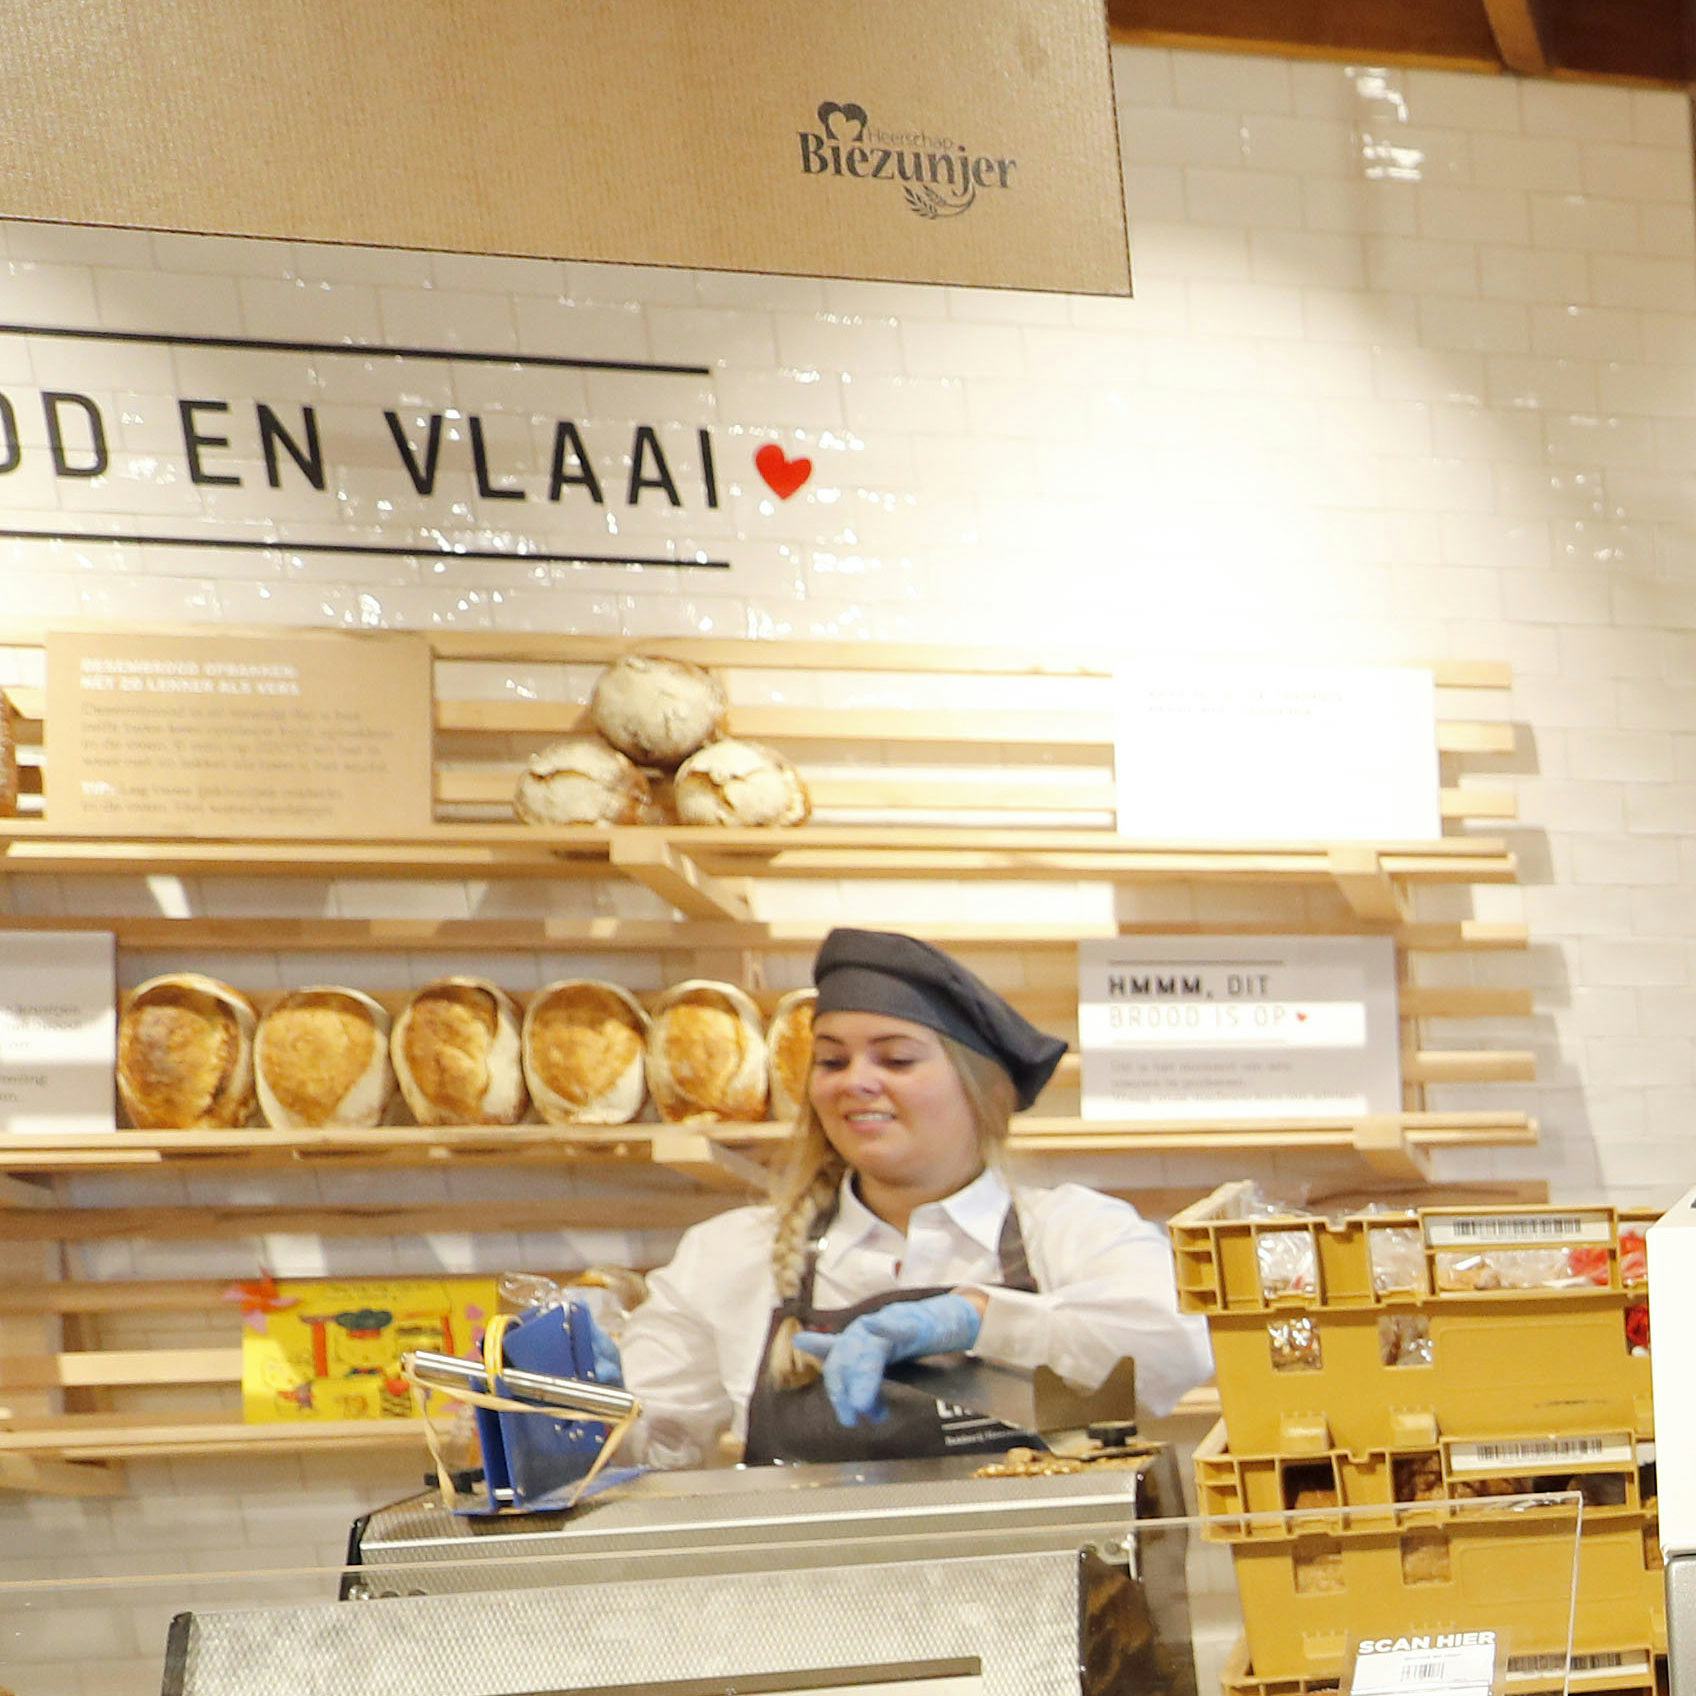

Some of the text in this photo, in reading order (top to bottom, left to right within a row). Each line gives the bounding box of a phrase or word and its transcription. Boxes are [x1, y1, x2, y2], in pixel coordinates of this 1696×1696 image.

[797, 131, 1017, 197] Biezunjer
[179, 400, 327, 492] EN
[383, 411, 719, 510] VLAAI
[1108, 974, 1270, 999] HMMM, DIT
[1110, 1005, 1200, 1028] BROOD
[1358, 1631, 1496, 1654] SCAN HIER
